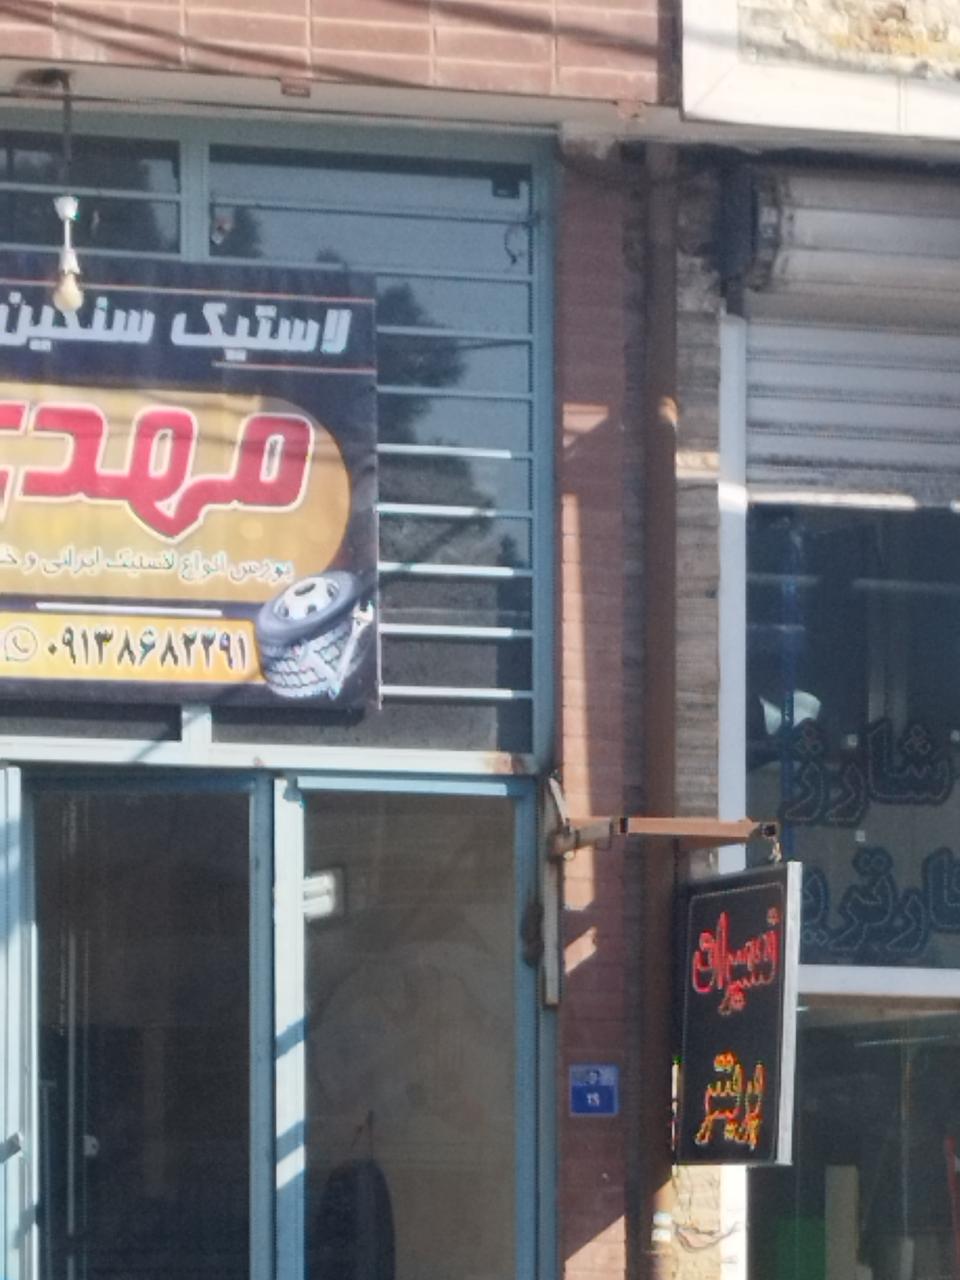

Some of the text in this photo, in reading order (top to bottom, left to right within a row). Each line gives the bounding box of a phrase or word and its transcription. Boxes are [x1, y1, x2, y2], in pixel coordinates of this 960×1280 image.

[171, 302, 352, 360] لاستیک
[0, 401, 316, 544] مهد
[22, 552, 38, 575] و
[179, 551, 228, 583] انواع
